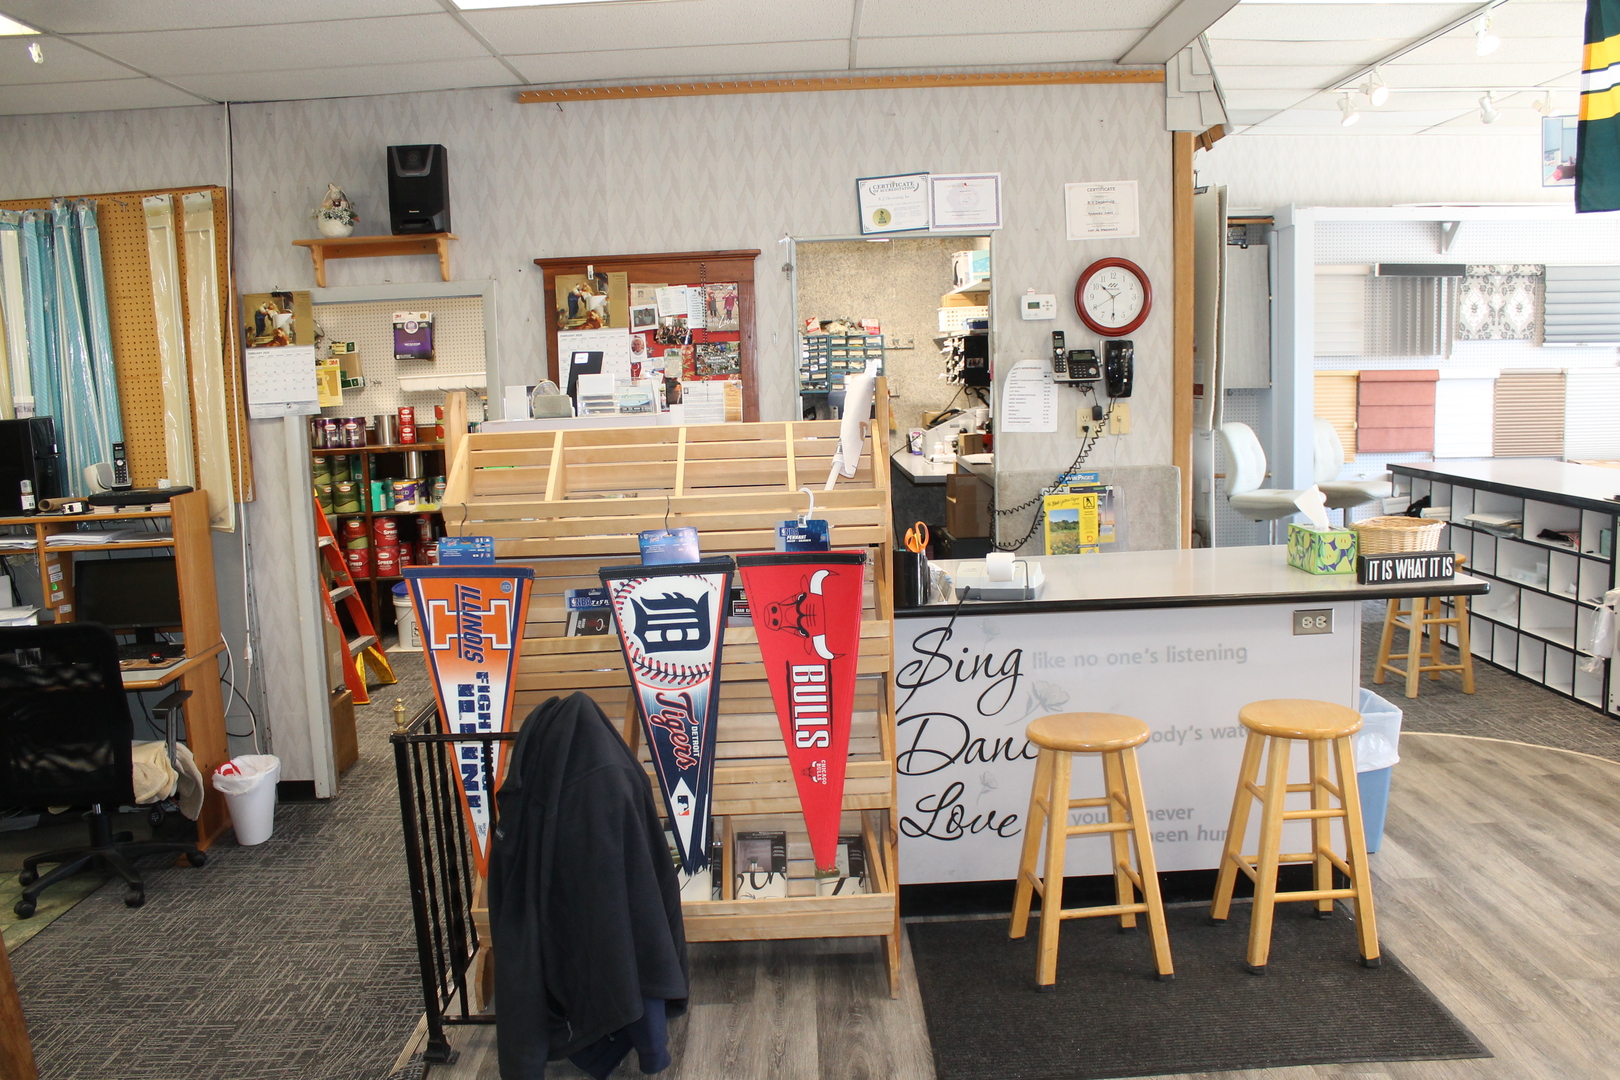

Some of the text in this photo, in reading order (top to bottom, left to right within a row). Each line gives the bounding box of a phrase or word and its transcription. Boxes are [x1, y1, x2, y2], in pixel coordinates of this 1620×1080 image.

[872, 181, 915, 190] CERTIFICATE
[1368, 556, 1452, 581] IT IS WHAT IT IS
[460, 585, 484, 664] ILLINOIS
[896, 627, 1024, 716] Sing
[1032, 643, 1248, 669] like no one's listening
[650, 692, 700, 770] Tigers
[792, 664, 830, 748] BULLS
[690, 726, 700, 757] DETROIT
[896, 712, 1038, 776] Danc
[900, 781, 1022, 841] Love
